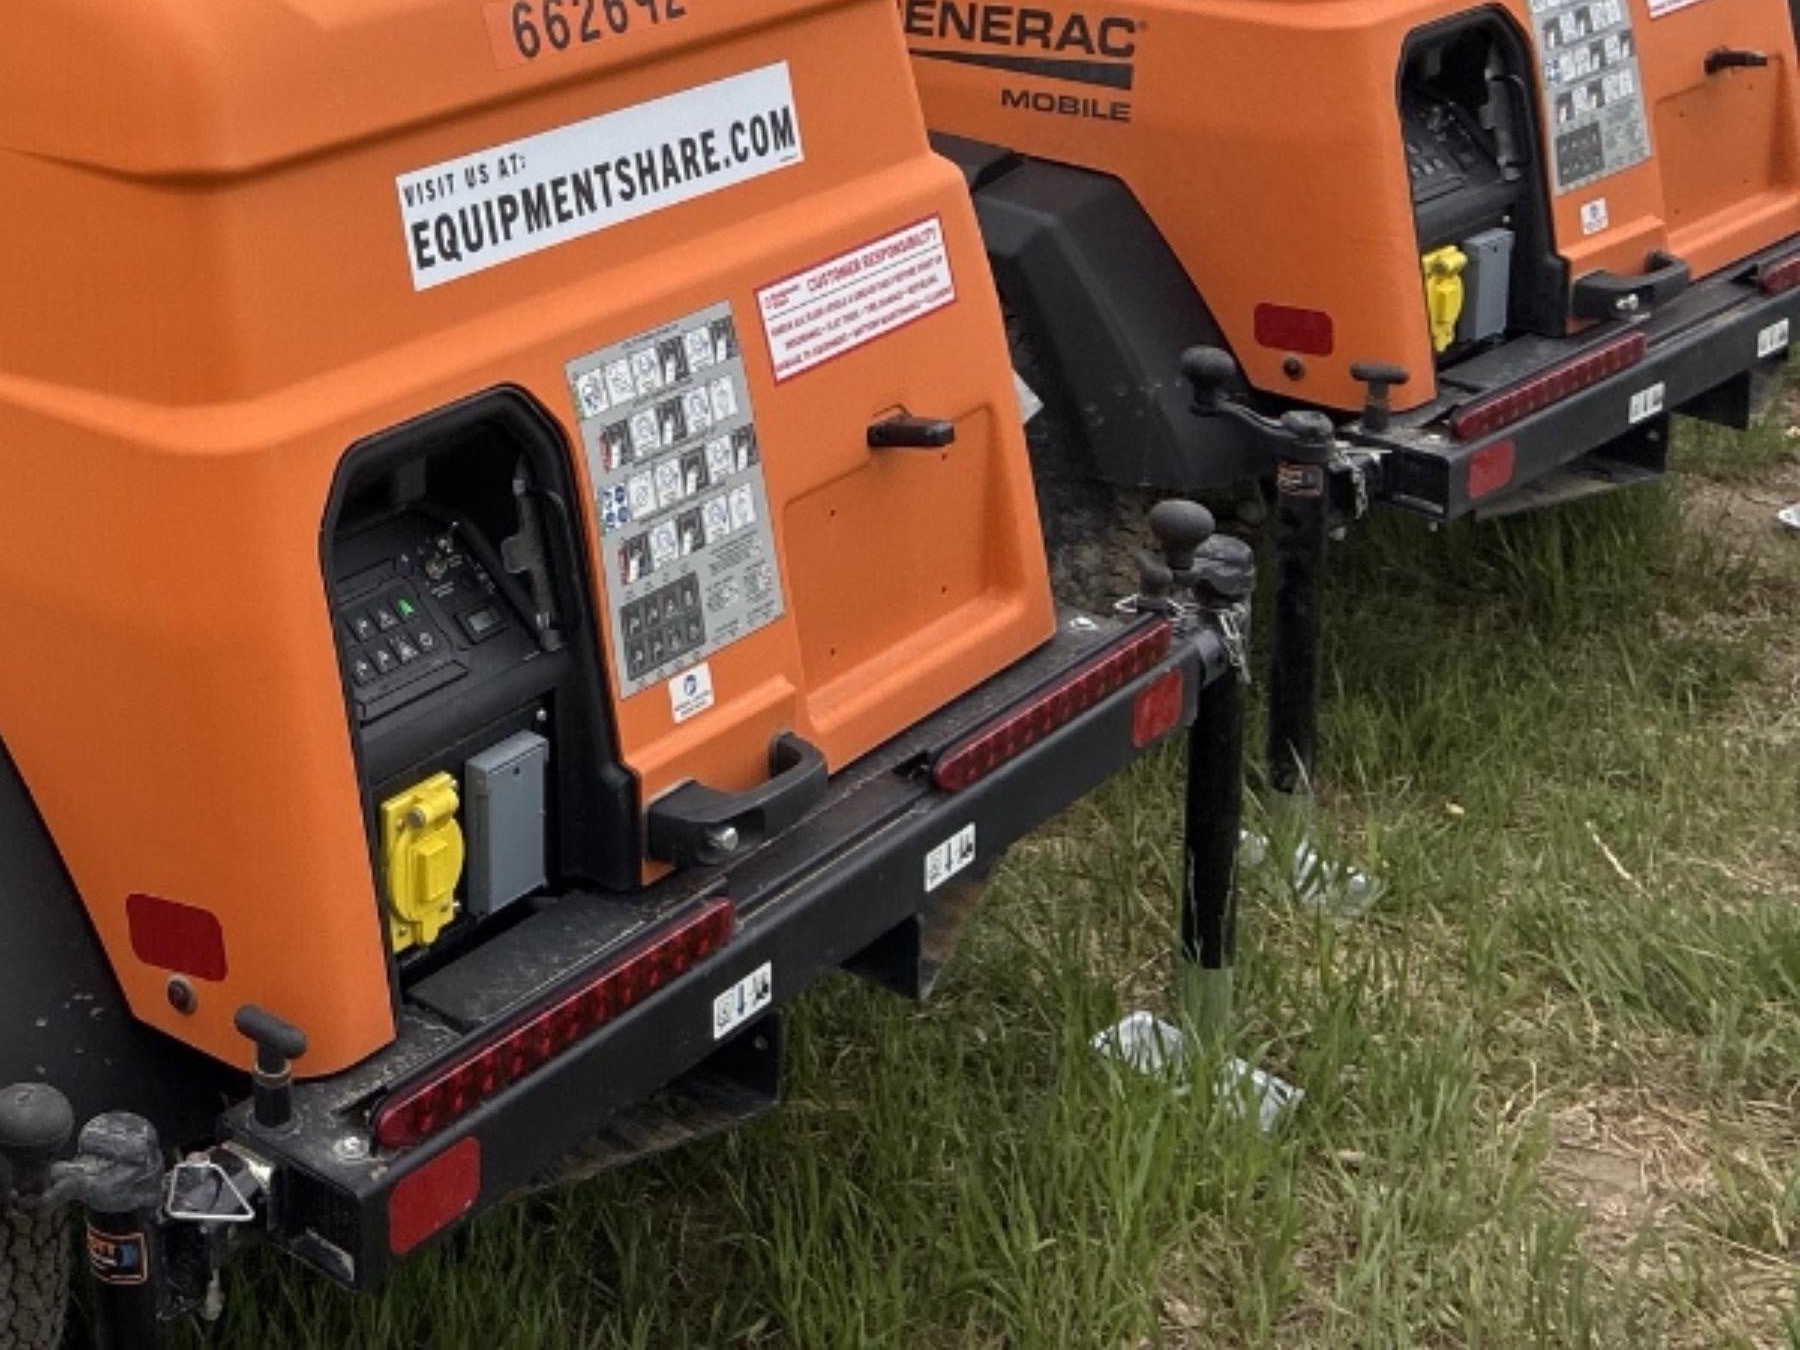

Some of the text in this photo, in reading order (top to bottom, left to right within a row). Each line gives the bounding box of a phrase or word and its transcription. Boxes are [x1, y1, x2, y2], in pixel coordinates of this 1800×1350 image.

[1001, 89, 1131, 122] MOBILE
[404, 152, 527, 208] VISIT US AT:
[411, 106, 797, 272] EQUIPMENTSHARE.COM
